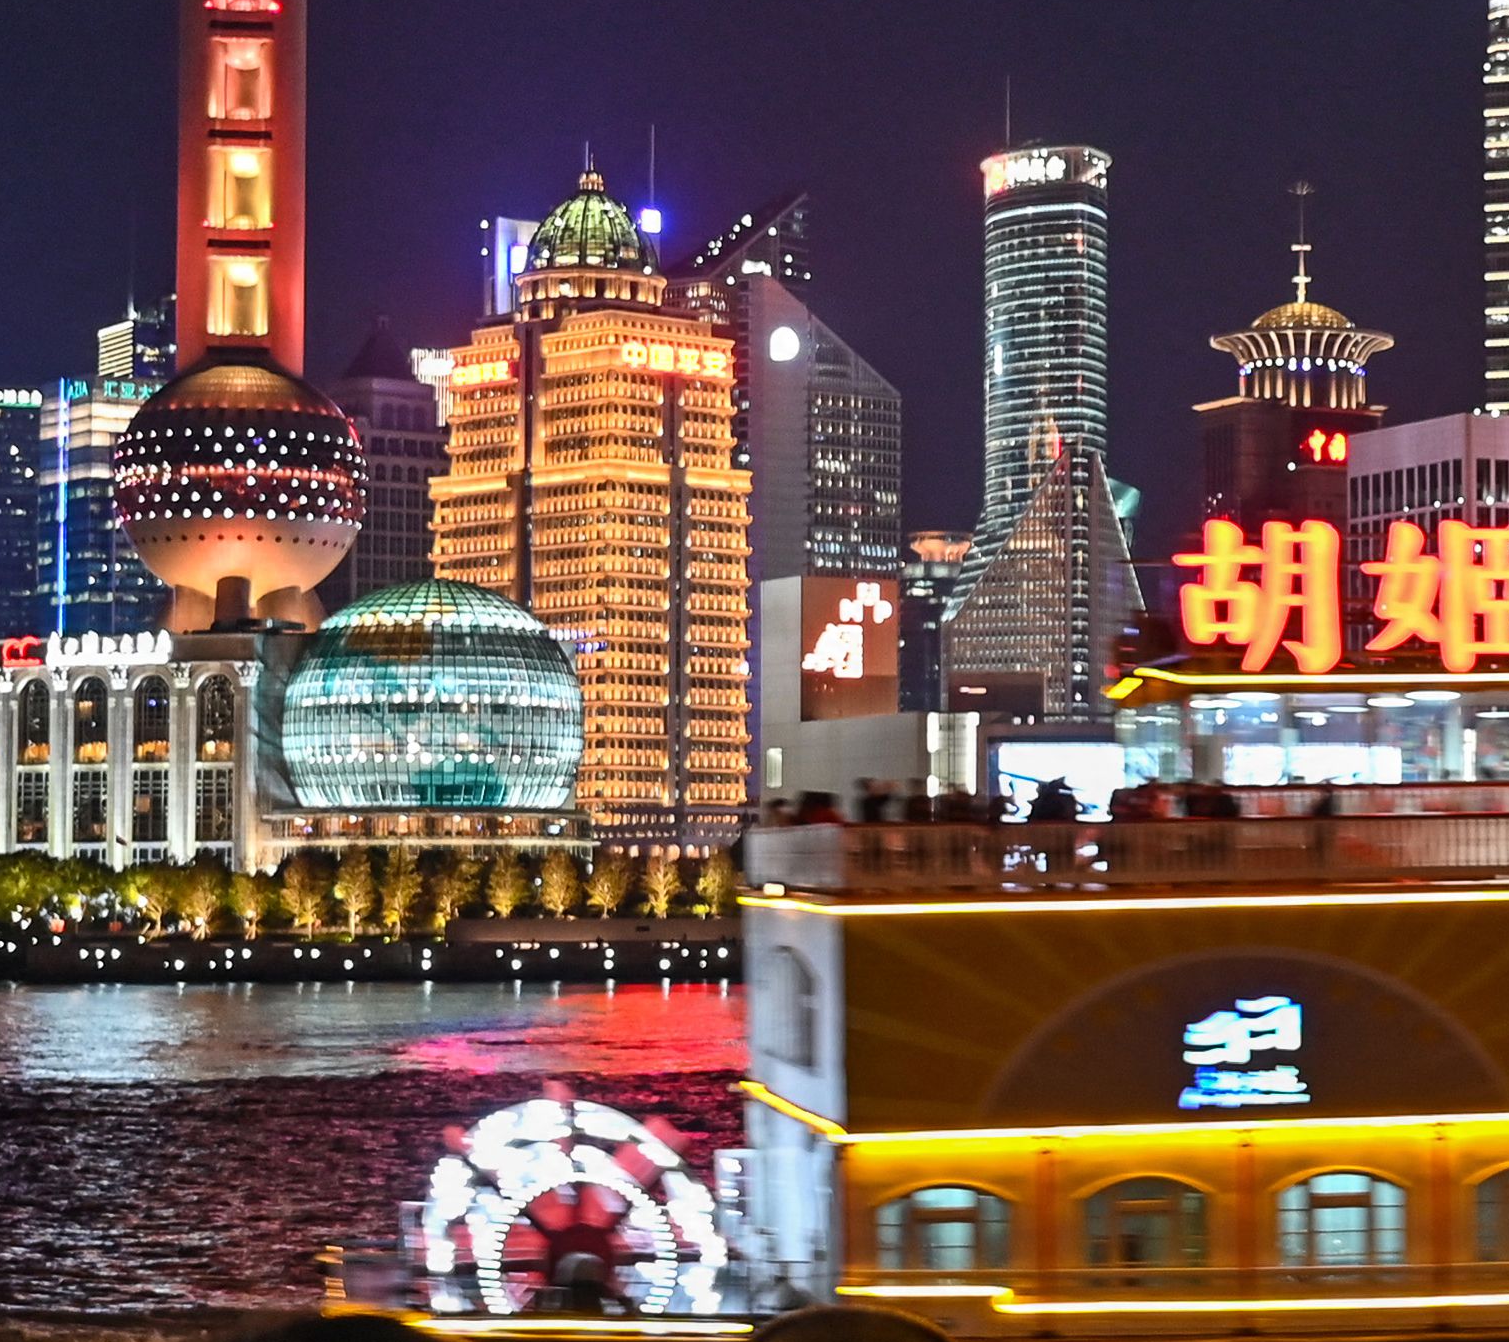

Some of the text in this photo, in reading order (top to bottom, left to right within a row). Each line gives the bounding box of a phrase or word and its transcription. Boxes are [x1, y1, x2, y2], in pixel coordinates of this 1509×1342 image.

[622, 341, 727, 376] 中国平安
[103, 379, 164, 401] 汇亚大
